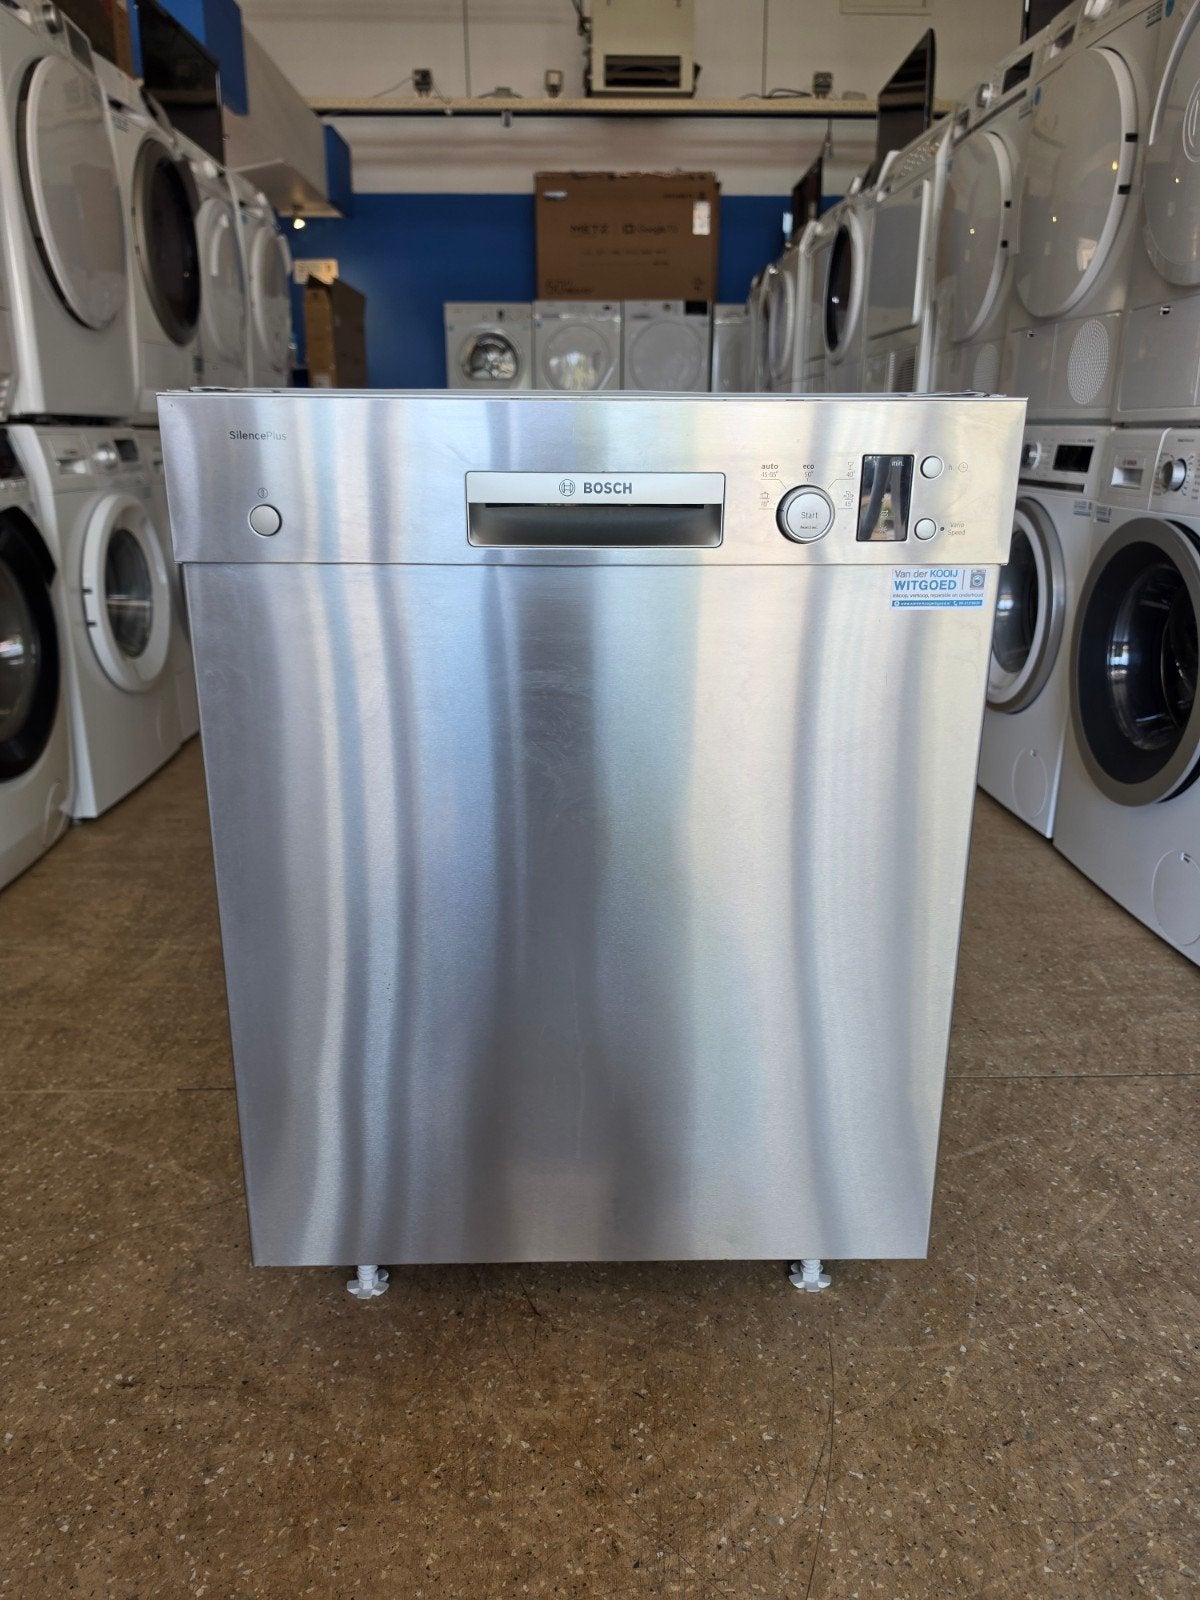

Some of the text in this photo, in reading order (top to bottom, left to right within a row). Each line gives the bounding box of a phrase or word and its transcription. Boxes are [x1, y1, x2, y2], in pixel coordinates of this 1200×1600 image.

[229, 430, 287, 440] SilencePlus
[583, 482, 633, 494] BOSCH
[800, 511, 818, 519] Start
[947, 529, 966, 537] Speed
[894, 569, 959, 578] Van der KOOIJ
[894, 579, 957, 591] WITGOED
